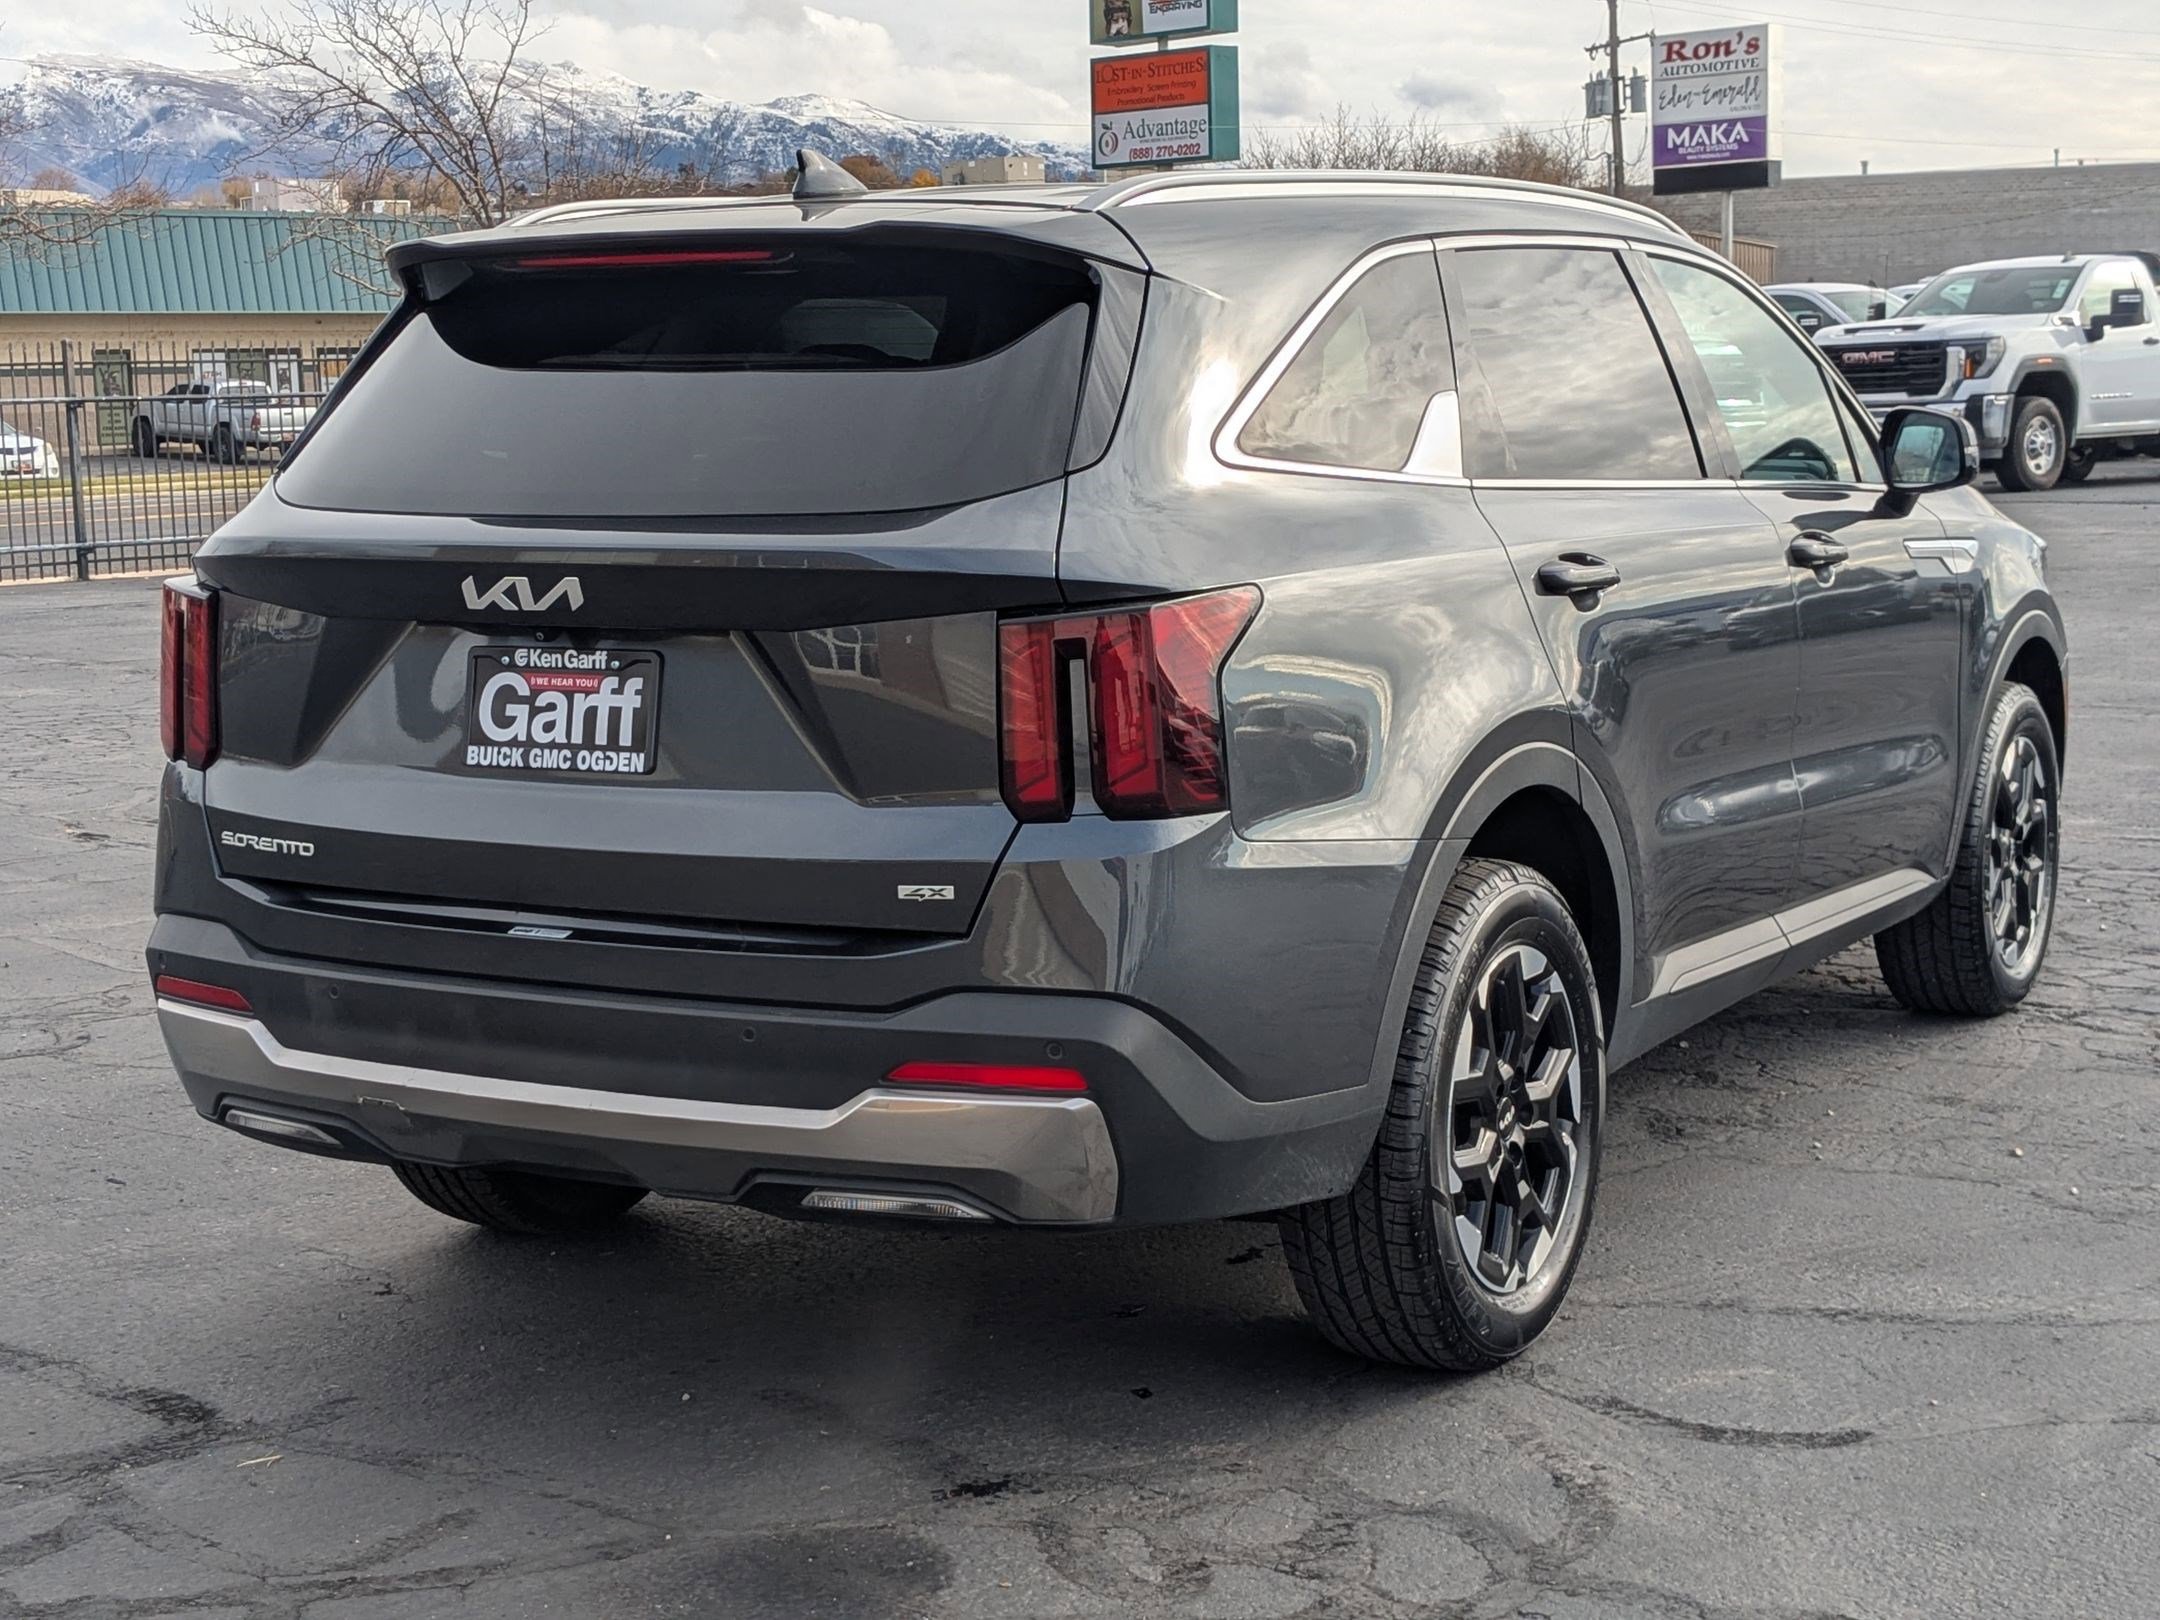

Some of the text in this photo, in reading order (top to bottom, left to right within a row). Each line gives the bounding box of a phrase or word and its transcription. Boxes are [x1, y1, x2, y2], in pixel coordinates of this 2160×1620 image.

[1148, 0, 1202, 15] ENGRAVING
[1659, 30, 1761, 64] Ron's
[1660, 57, 1760, 77] AUTOMOTIVE
[1122, 118, 1207, 140] Advantage
[1667, 120, 1750, 149] MAKA
[1156, 143, 1201, 158] 270-0202
[1841, 351, 1896, 364] GMC
[461, 575, 584, 611] KIA
[536, 677, 593, 687] WE HEAR YOU
[479, 671, 644, 747] Garff
[466, 745, 645, 773] BUICK GMC OGDEN
[221, 831, 315, 857] SORENTO
